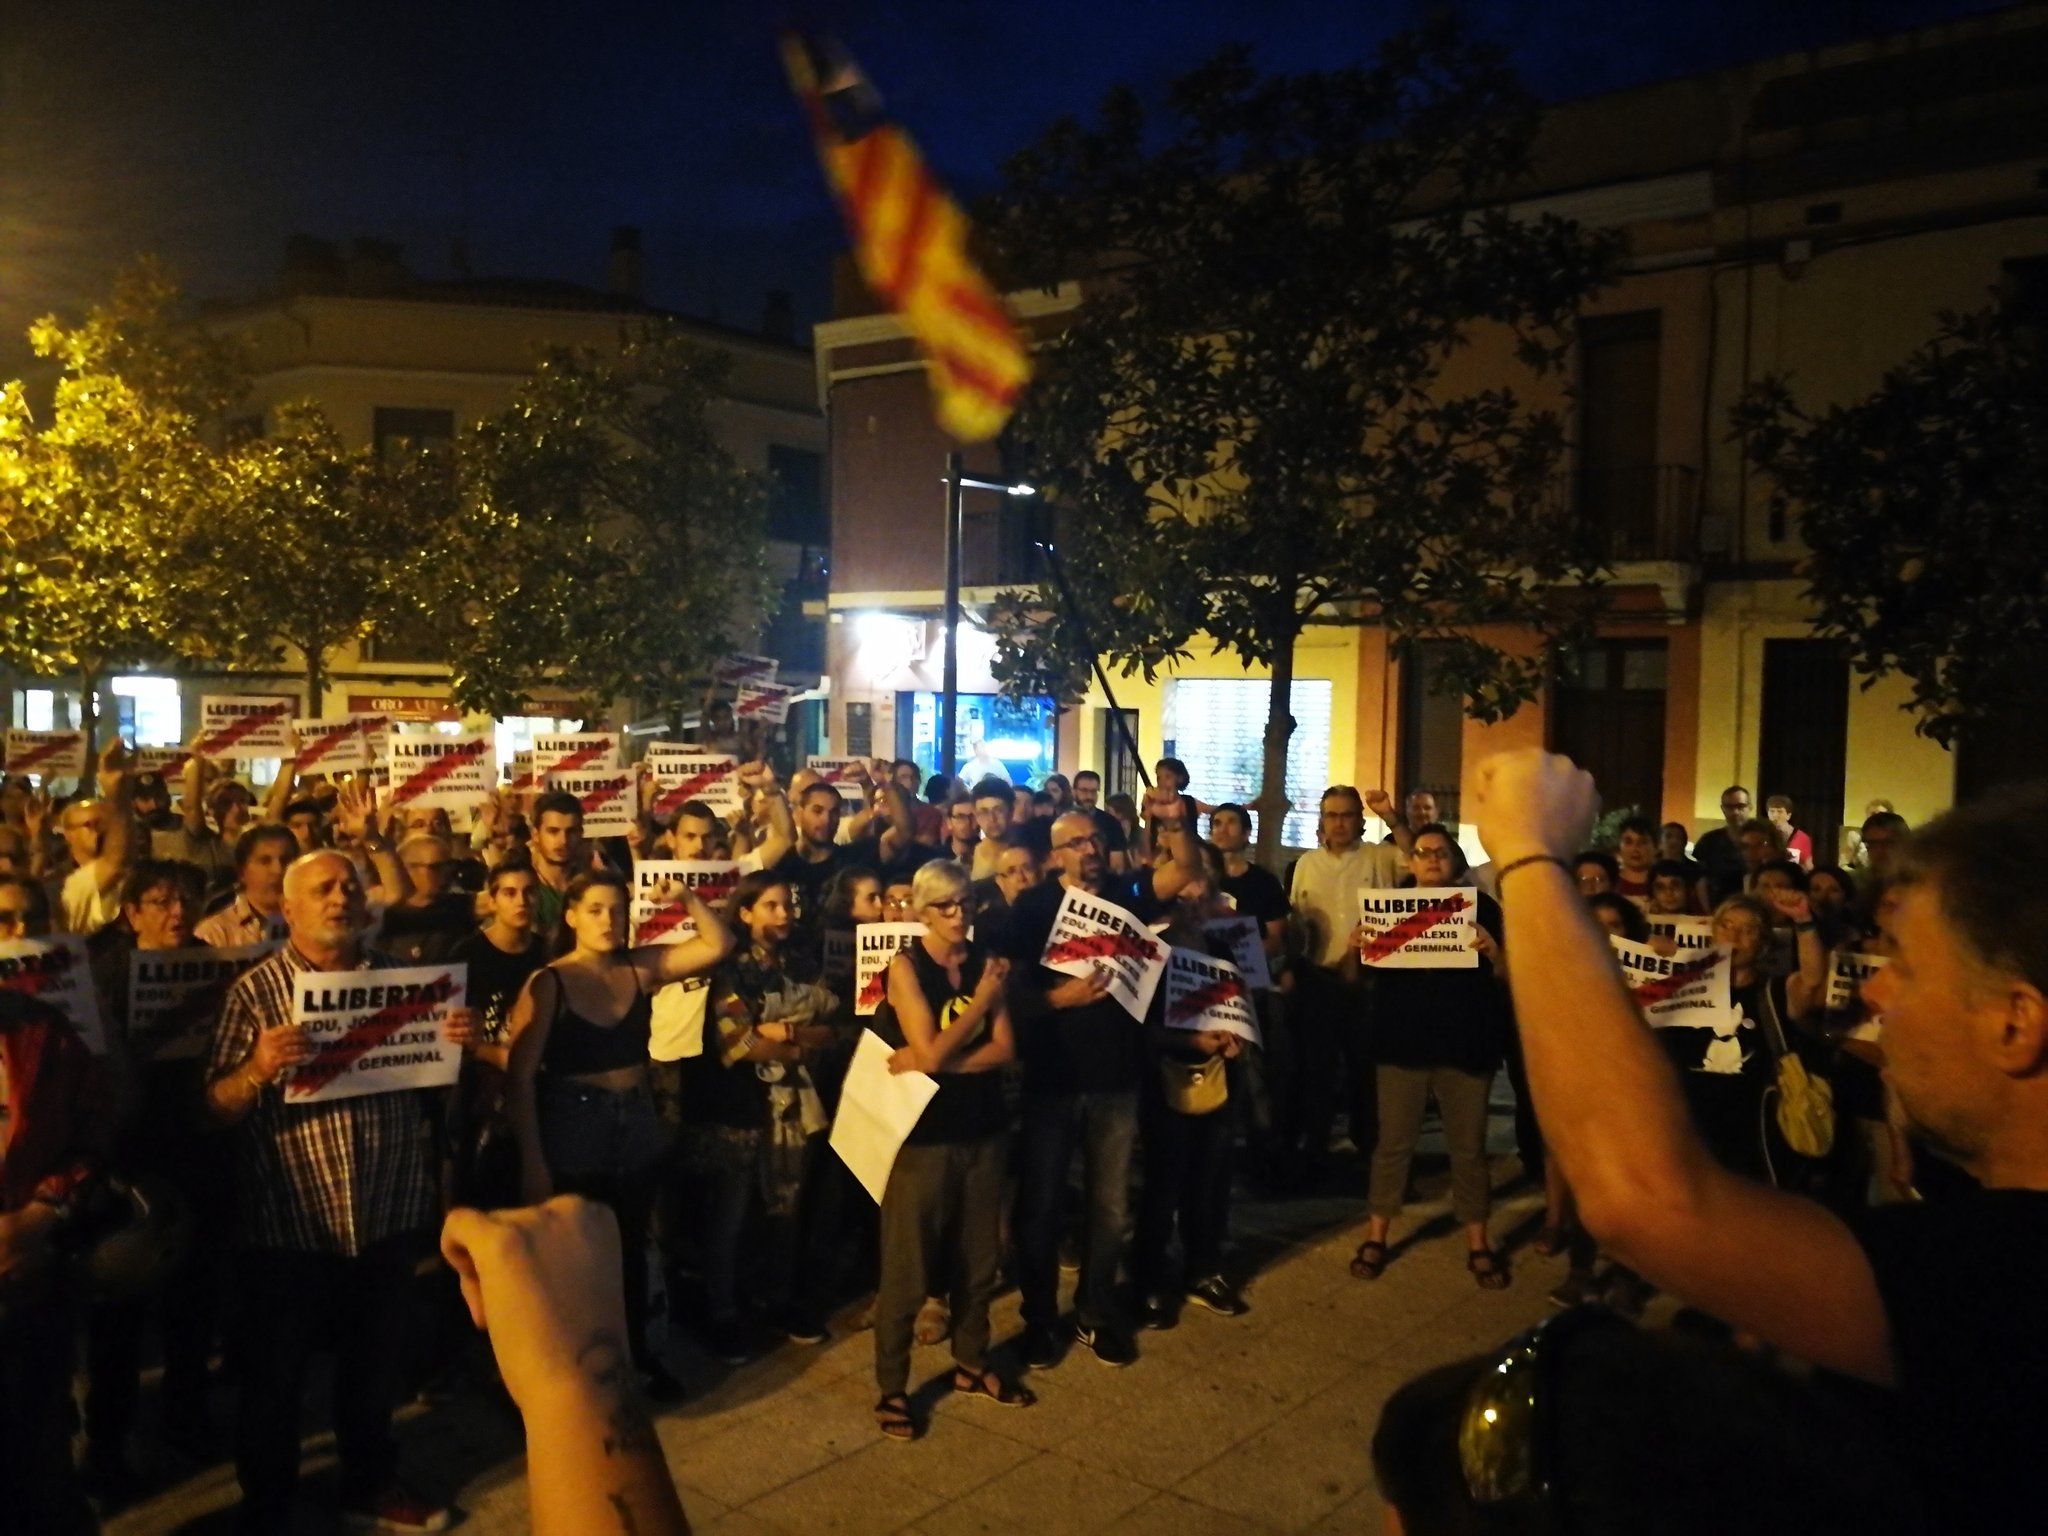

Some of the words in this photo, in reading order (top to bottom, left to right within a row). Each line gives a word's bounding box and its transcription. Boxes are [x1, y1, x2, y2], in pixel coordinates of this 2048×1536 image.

[1364, 915, 1390, 928] EDU,
[1404, 944, 1466, 953] GERMINAL
[358, 1050, 443, 1071] GERMINAL
